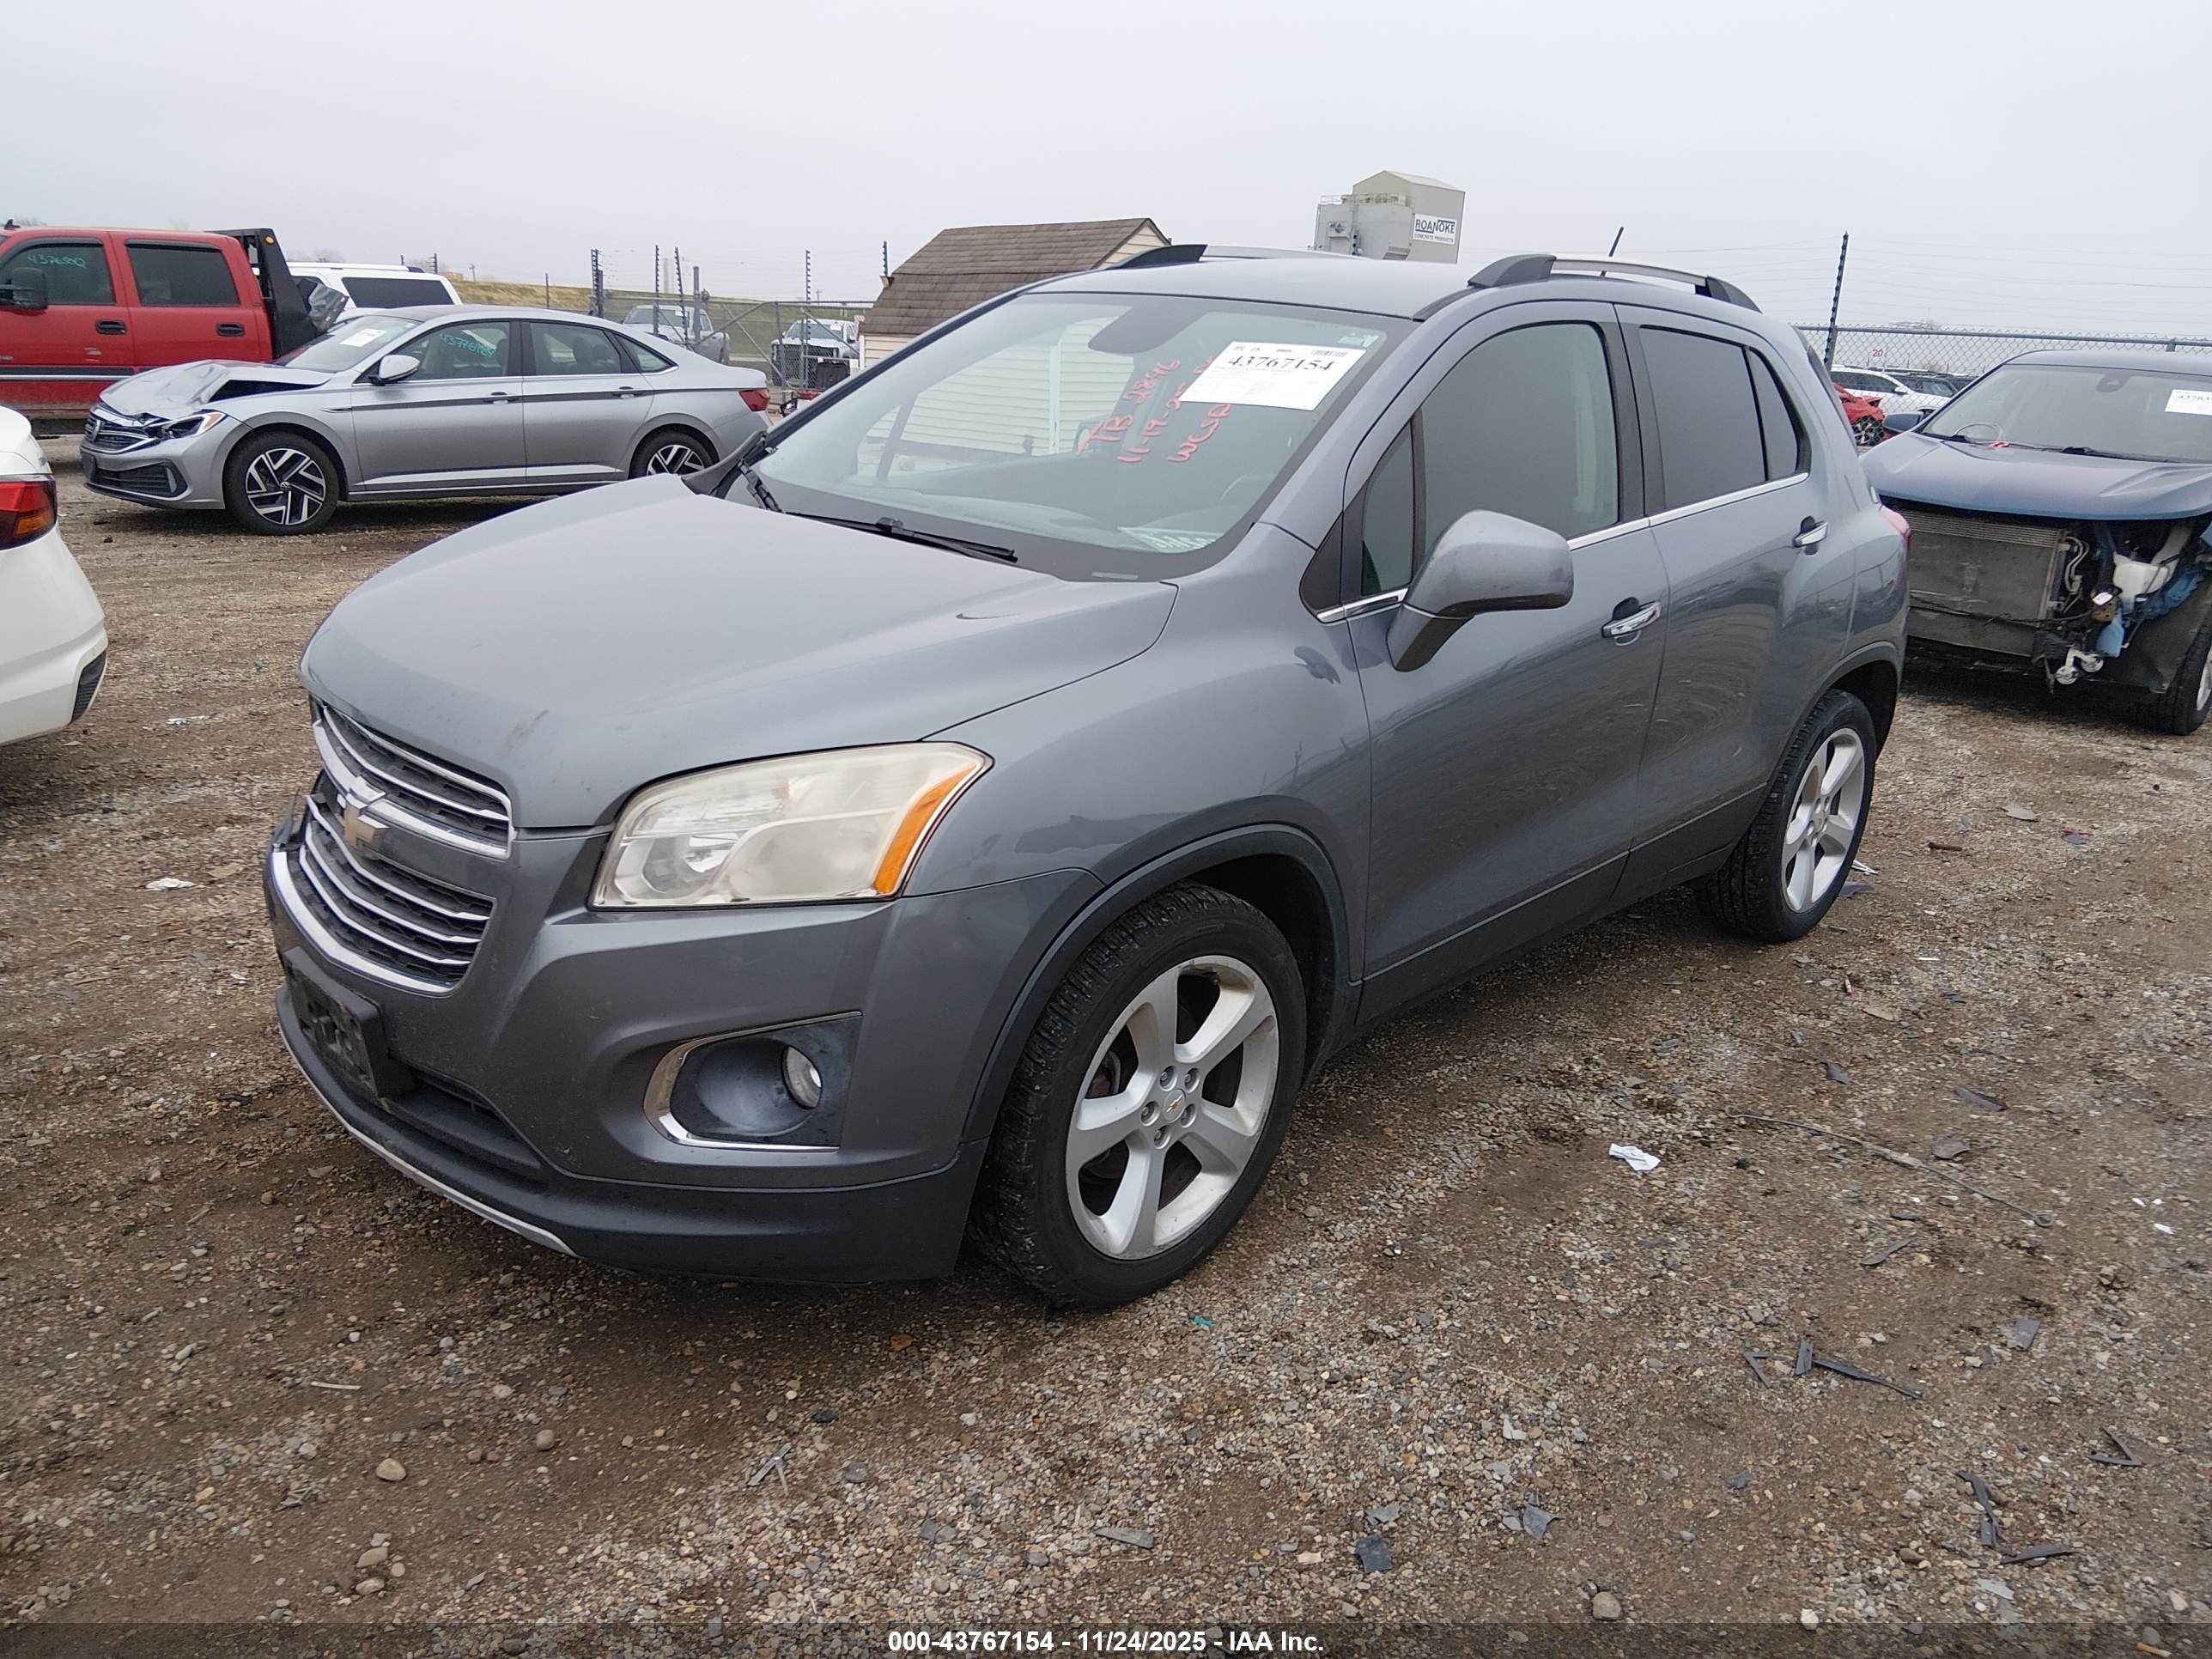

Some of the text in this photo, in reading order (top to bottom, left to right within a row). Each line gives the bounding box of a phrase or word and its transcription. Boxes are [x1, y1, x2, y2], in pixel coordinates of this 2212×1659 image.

[1415, 219, 1455, 234] ROANOKE
[1872, 349, 1883, 357] 20
[1228, 355, 1334, 371] 43767154
